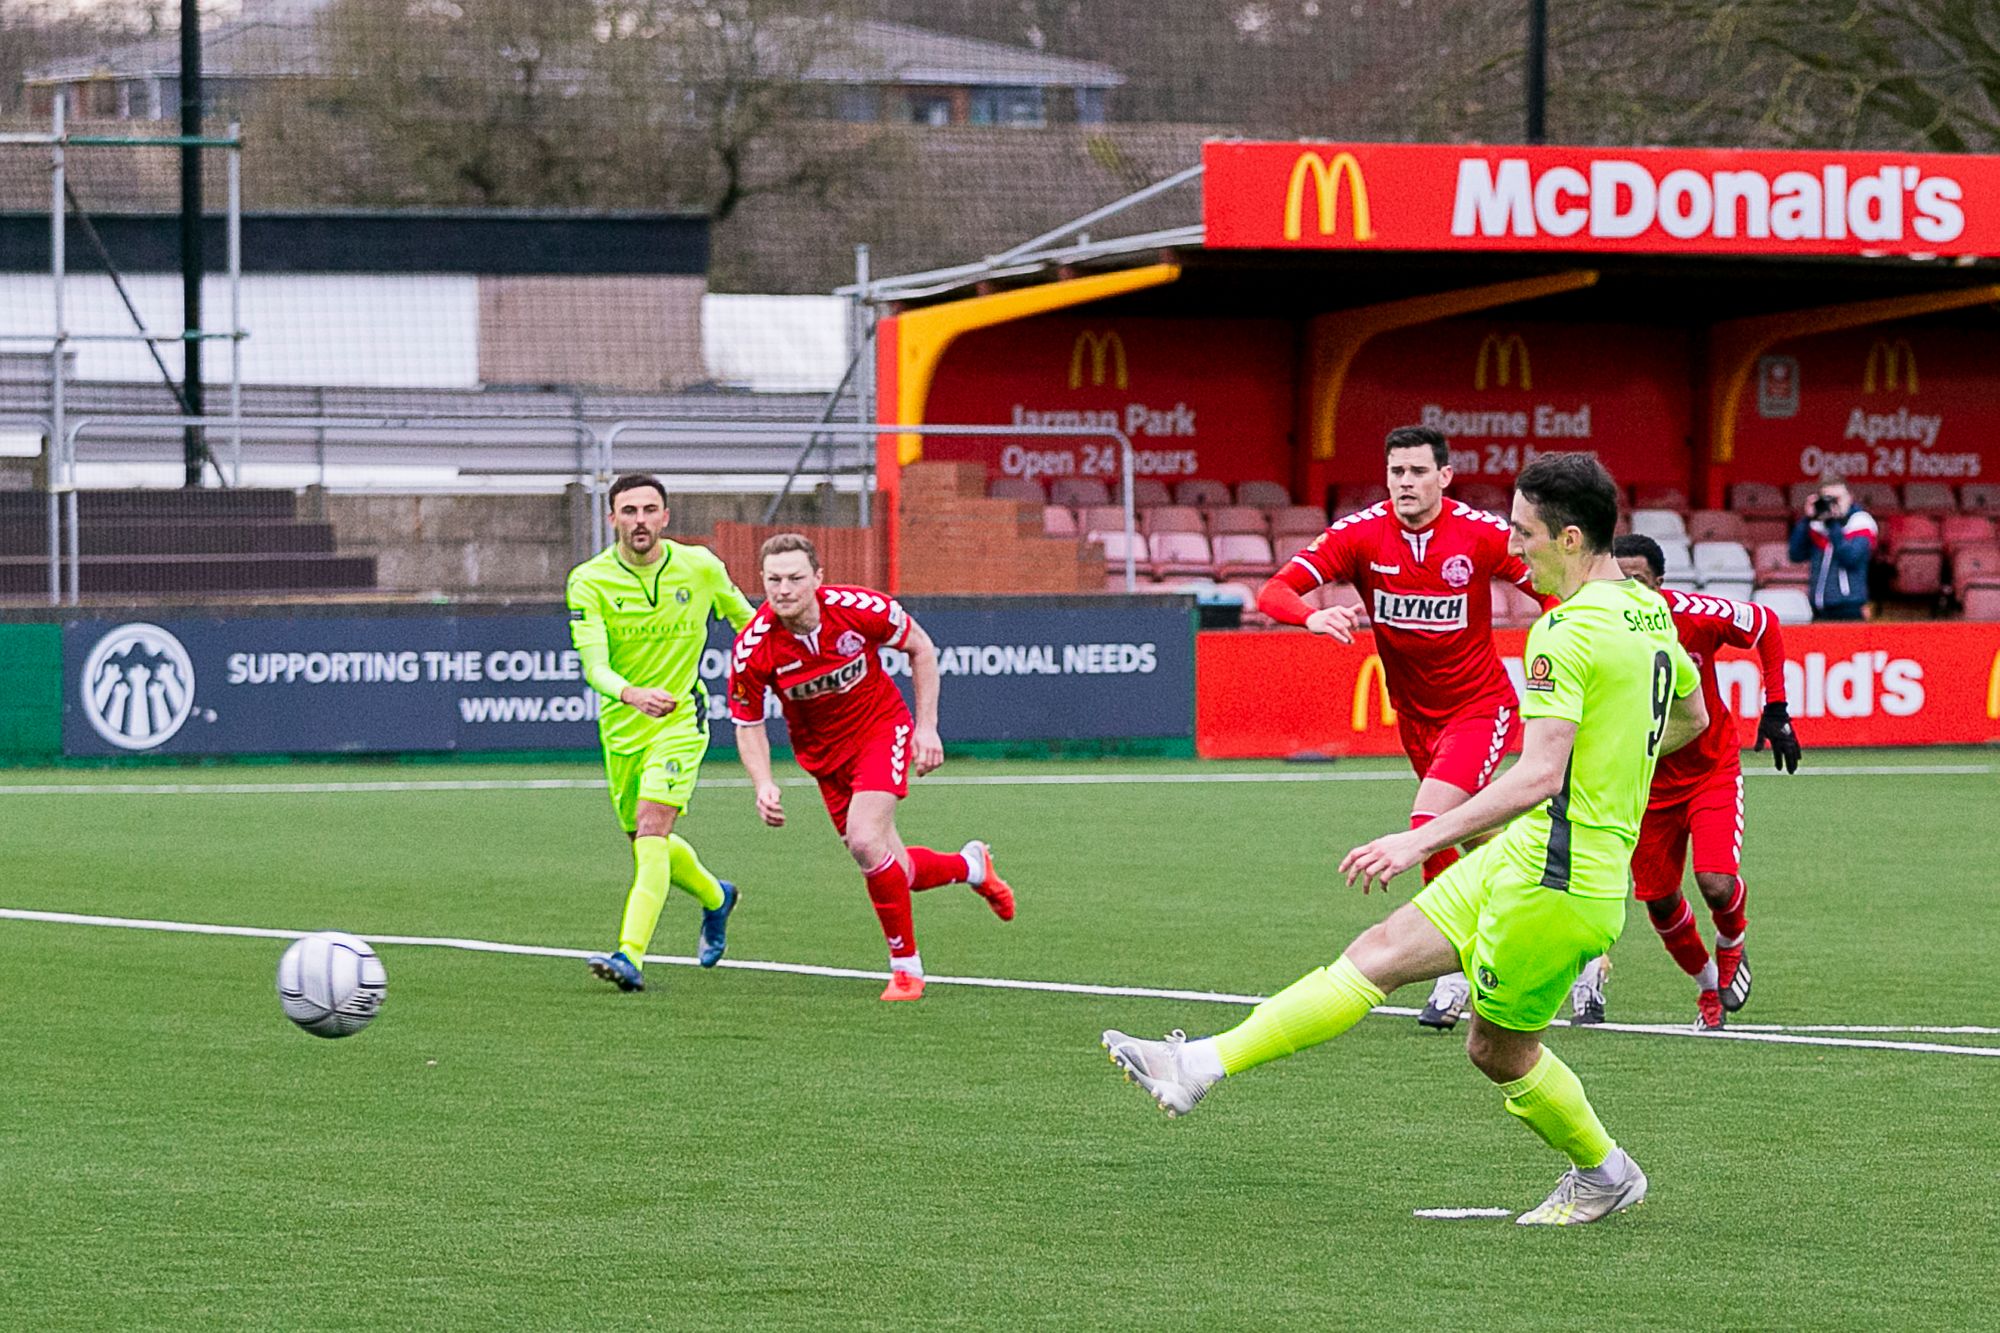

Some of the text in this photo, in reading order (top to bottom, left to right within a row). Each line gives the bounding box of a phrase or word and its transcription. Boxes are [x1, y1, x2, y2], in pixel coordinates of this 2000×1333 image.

[1450, 157, 1966, 242] McDonald's
[1124, 402, 1197, 437] Park
[1421, 403, 1592, 438] Bourne End
[1844, 406, 1942, 448] Apsley
[1001, 444, 1199, 482] Open 24 ours
[1450, 450, 1480, 475] en
[1484, 444, 1519, 475] 24
[1800, 445, 1982, 480] Open 24 hours
[226, 643, 1158, 684] SUPPORTING THE COLLE DUATIONAL NEEDS
[1647, 650, 1673, 757] 9
